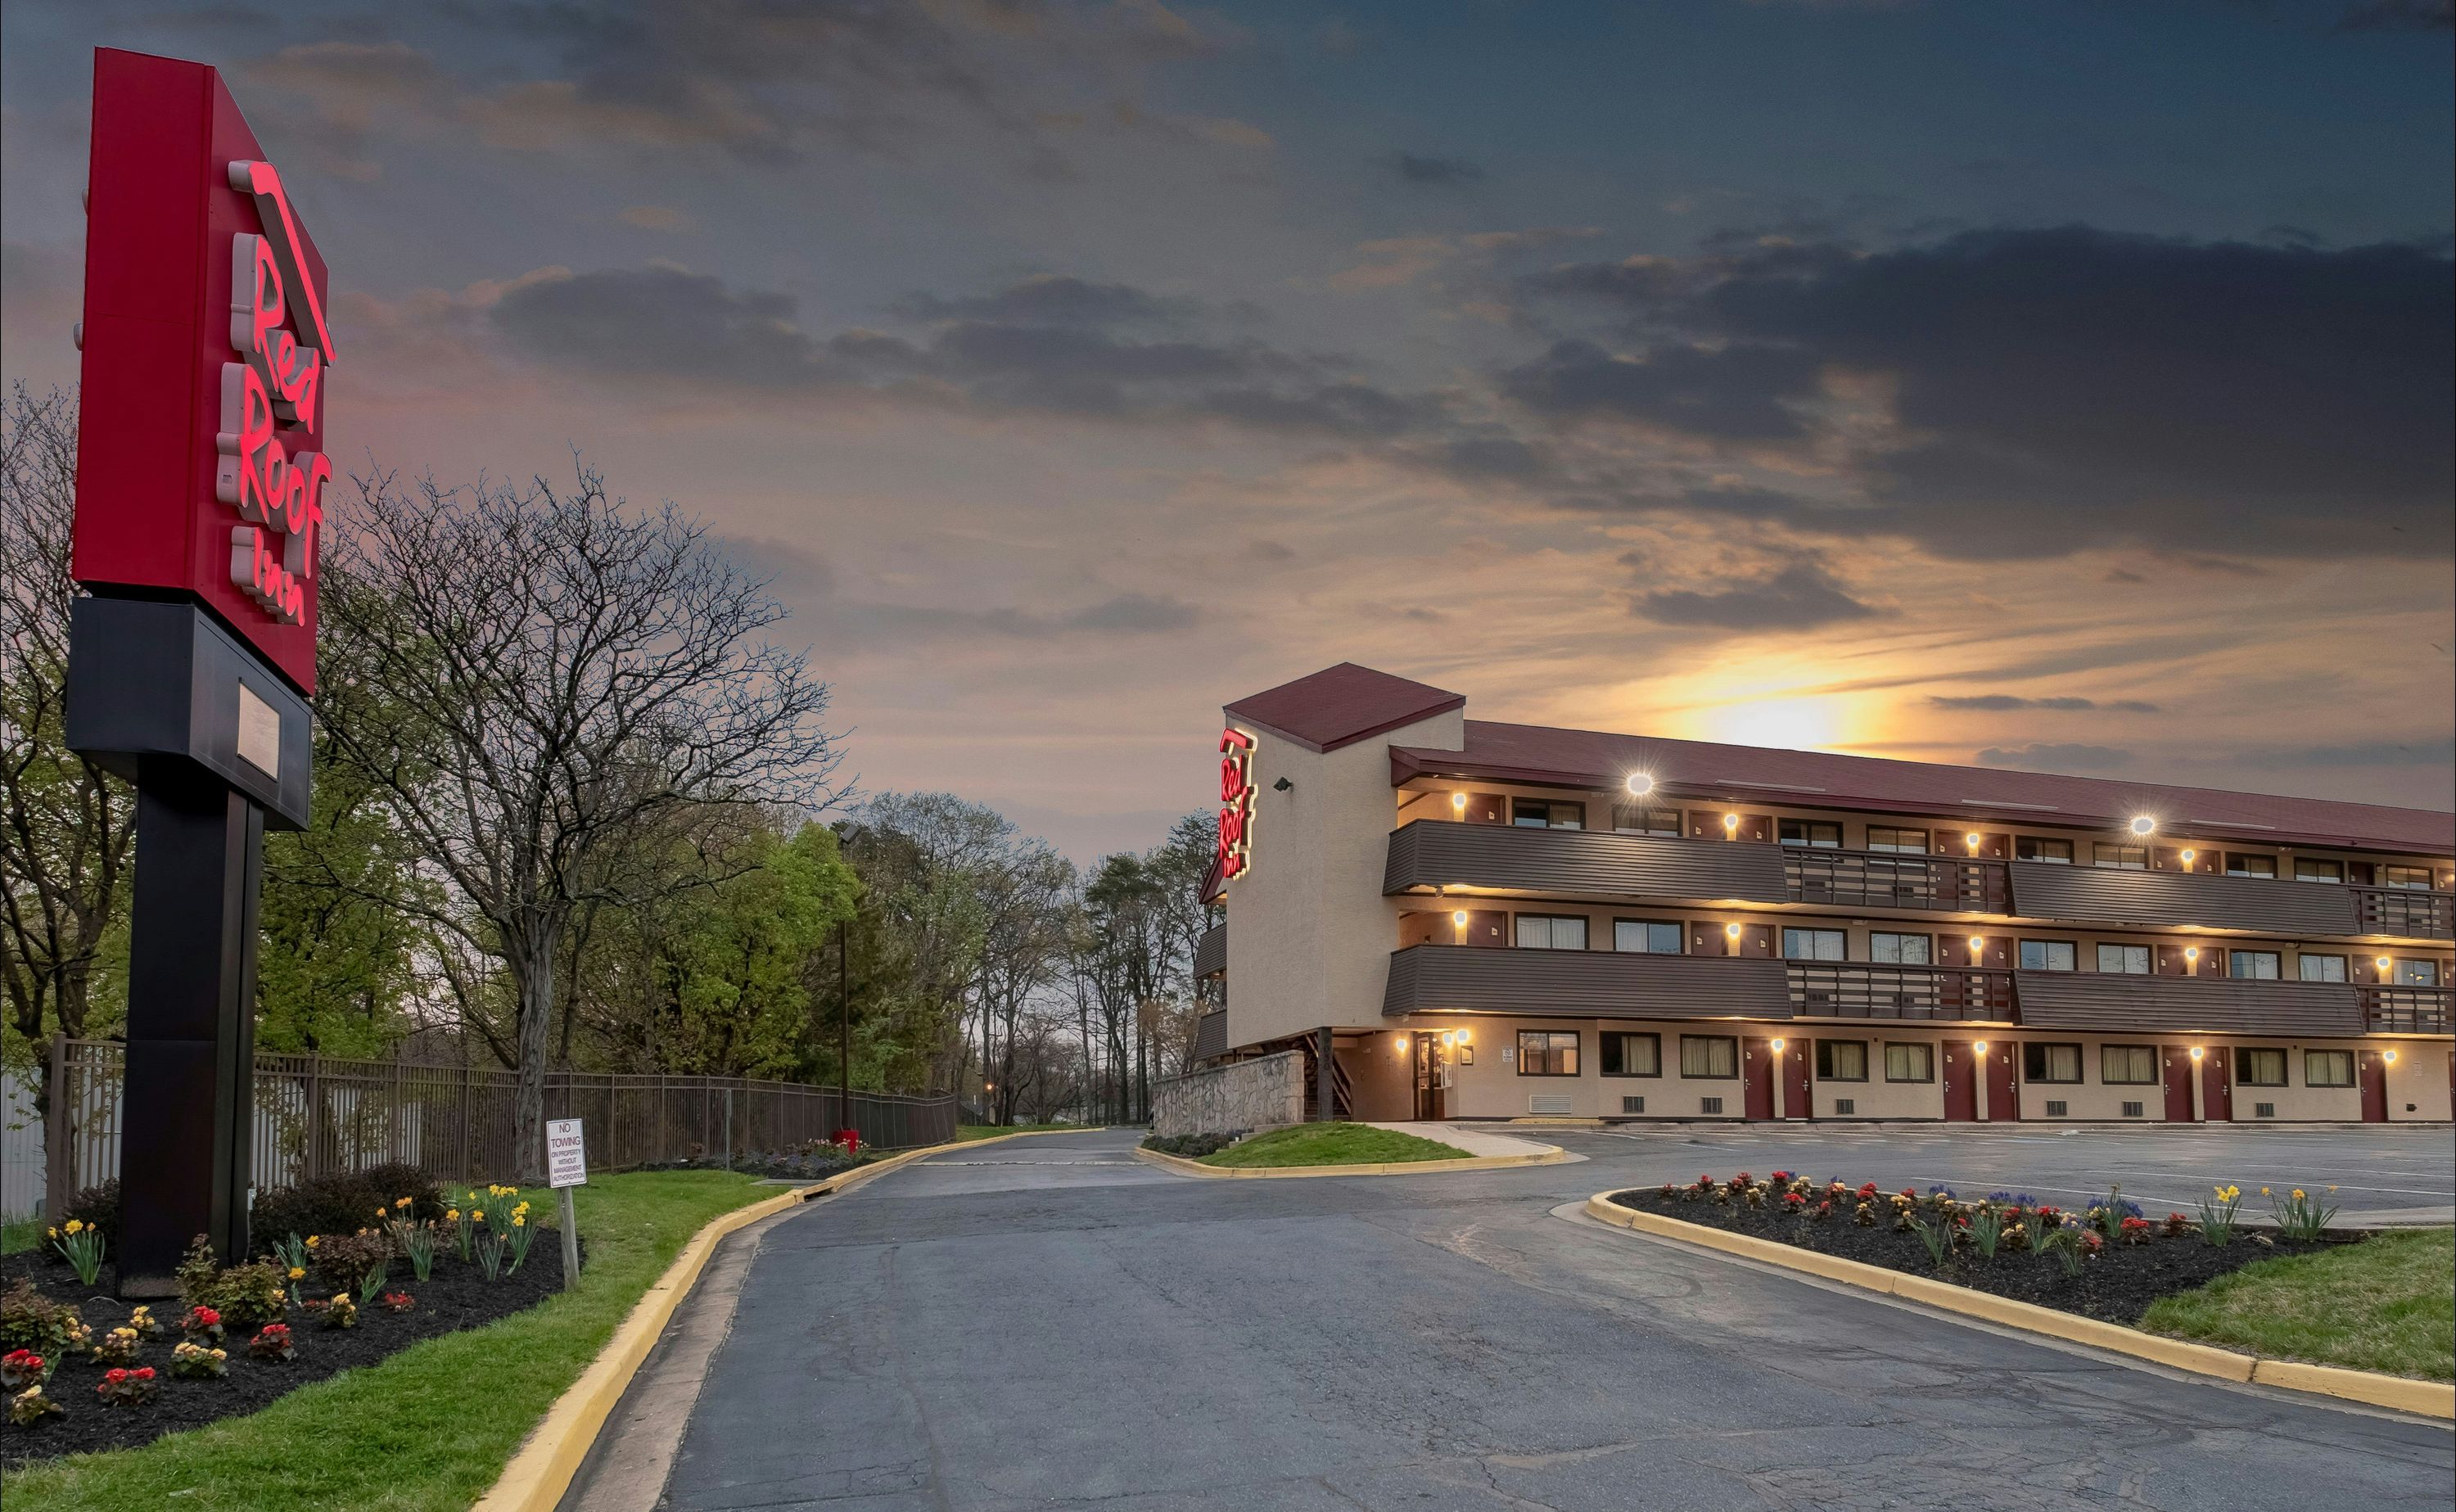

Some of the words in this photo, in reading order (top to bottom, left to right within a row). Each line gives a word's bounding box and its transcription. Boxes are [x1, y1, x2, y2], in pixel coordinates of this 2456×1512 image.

[253, 233, 321, 434] Red
[241, 363, 333, 580] Roof
[254, 526, 306, 627] Inn
[1221, 754, 1243, 801] Red
[1220, 786, 1248, 860] Roof
[551, 1136, 580, 1148] TOWING
[559, 1123, 571, 1133] NO
[553, 1164, 582, 1174] MANAGEMENT
